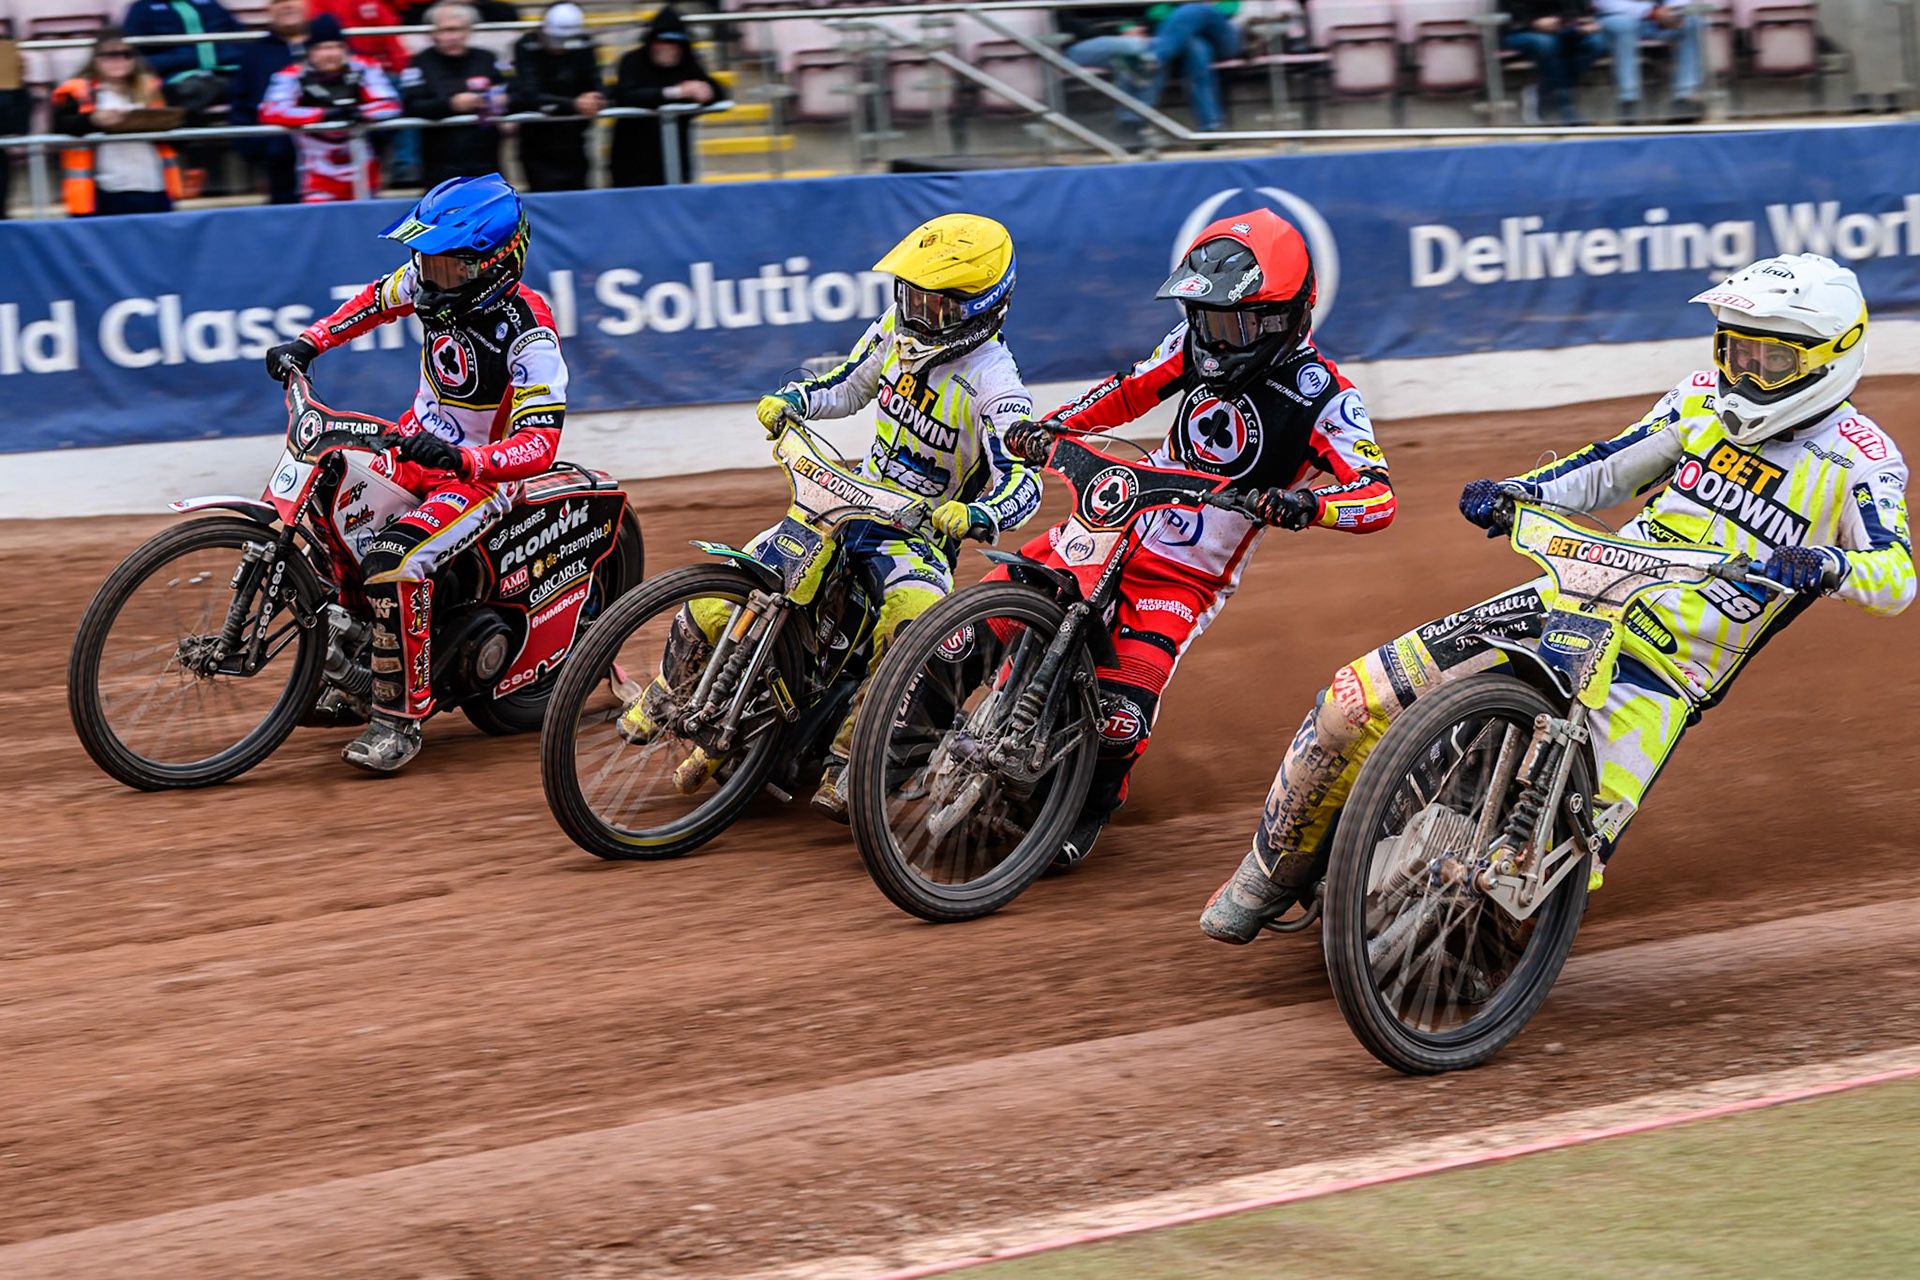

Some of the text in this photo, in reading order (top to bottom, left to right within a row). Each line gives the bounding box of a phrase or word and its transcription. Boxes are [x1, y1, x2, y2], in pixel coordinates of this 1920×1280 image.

[480, 232, 521, 270] OAKLEY
[1410, 194, 1920, 287] Delivering Worl
[1752, 266, 1794, 280] Arai
[595, 256, 898, 336] Solution
[101, 293, 315, 369] Class
[465, 347, 475, 372] ACES
[996, 403, 1032, 416] LUCAS
[334, 421, 379, 435] BETARD
[1243, 412, 1258, 444] ACES
[795, 458, 873, 507] BETGOODWIN
[1093, 469, 1136, 496] BELLE VUE ACES
[1708, 444, 1783, 496] BET
[500, 502, 590, 574] PŁOMYK
[510, 508, 547, 540] ŚRUBRES
[1069, 542, 1091, 555] ATPI
[1547, 537, 1670, 578] BETGOODWIN
[502, 571, 528, 592] AMD
[1136, 604, 1194, 624] PROPERTIES
[1421, 594, 1539, 641] Palle Phillip
[1628, 606, 1672, 648] TIMMO
